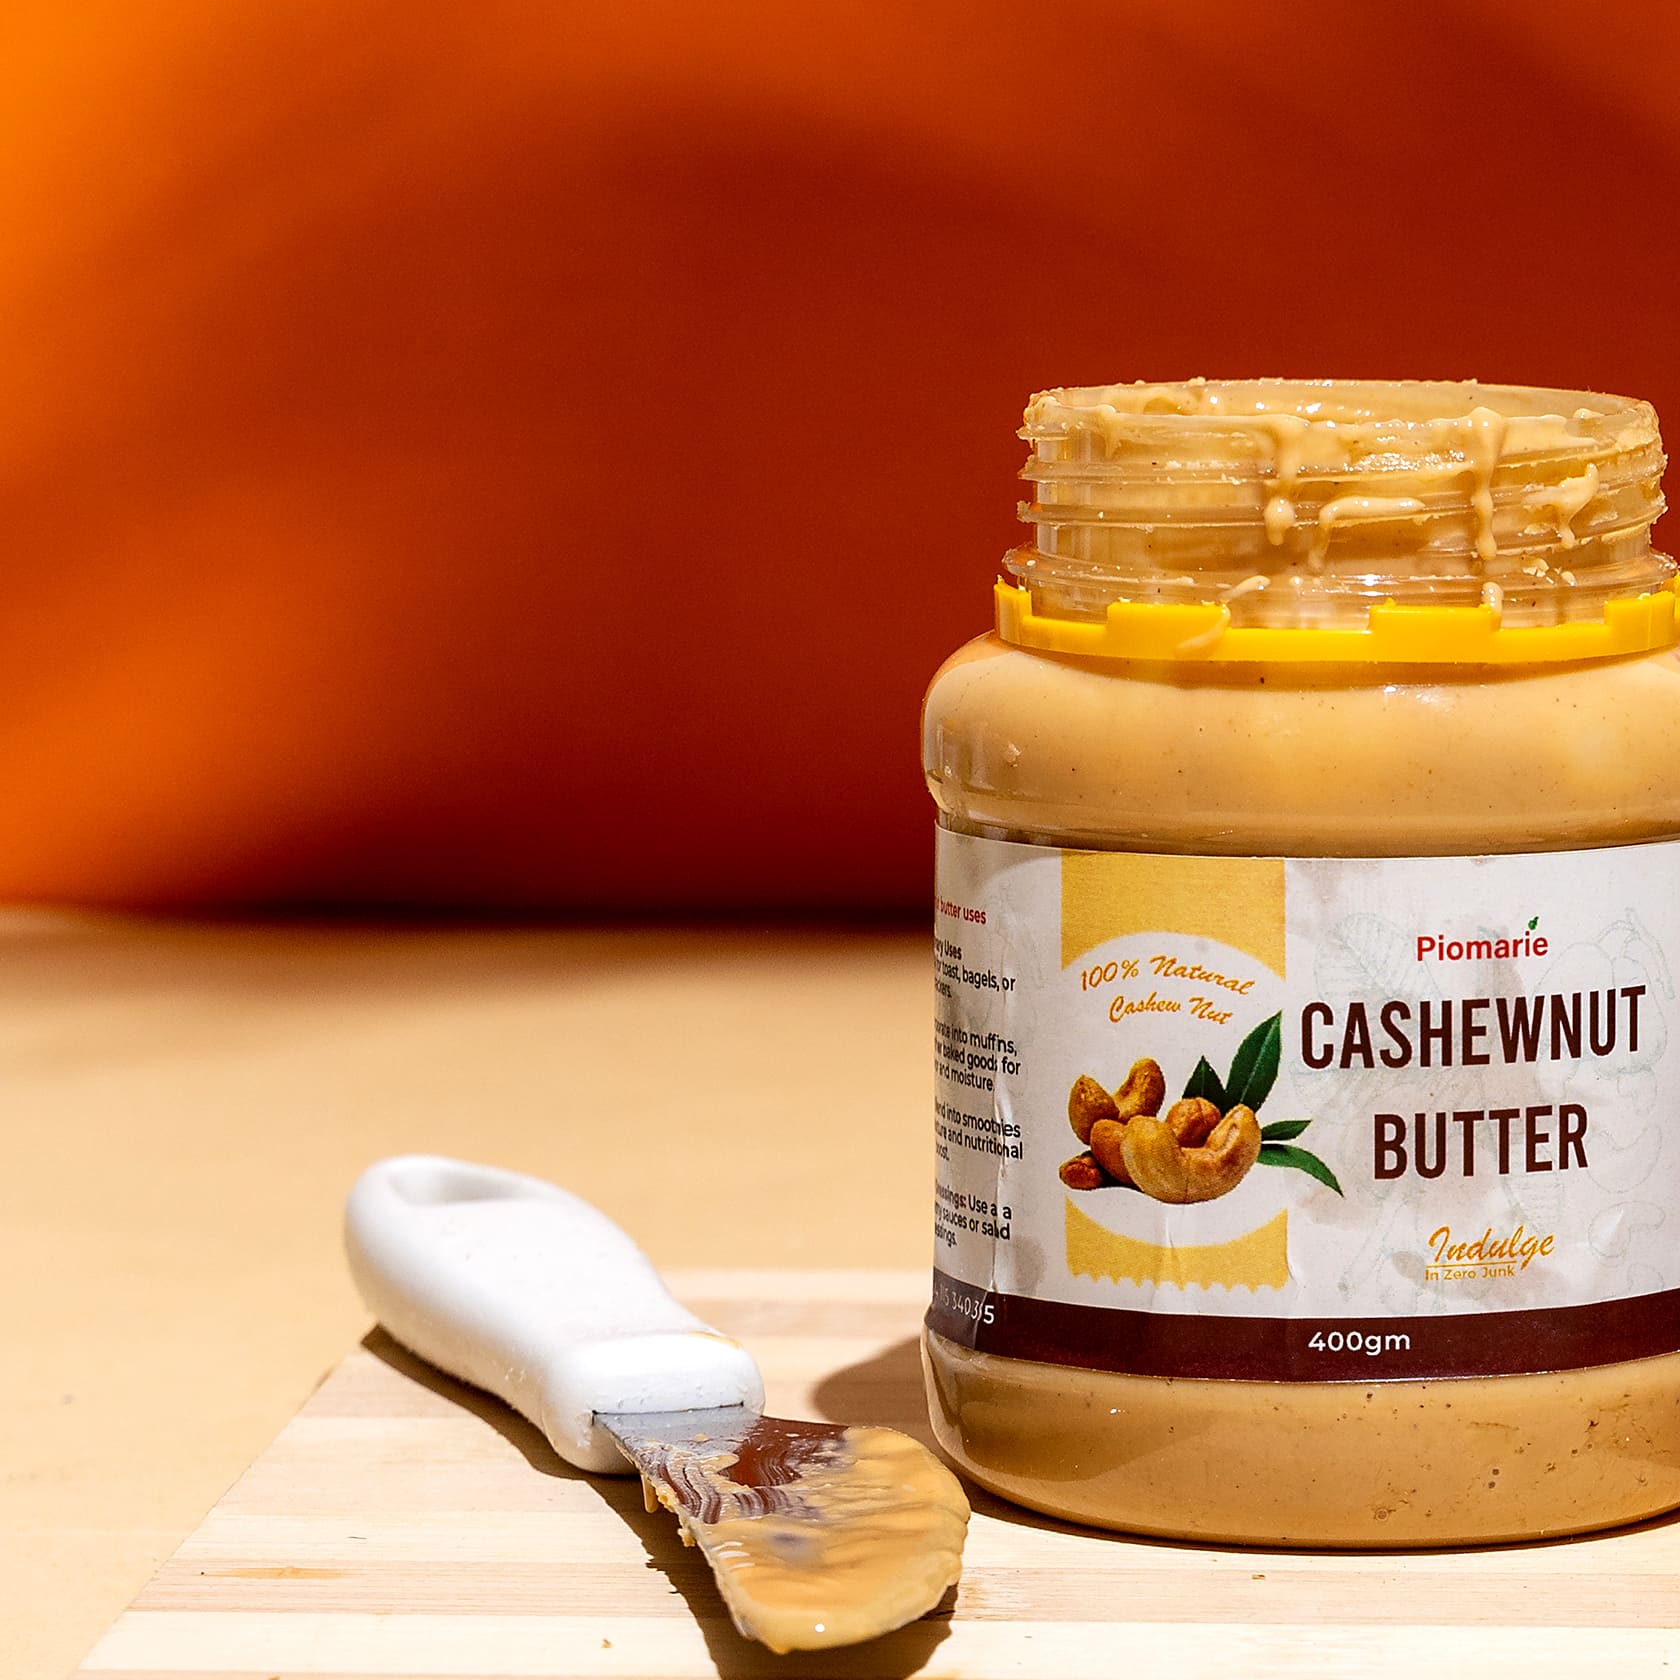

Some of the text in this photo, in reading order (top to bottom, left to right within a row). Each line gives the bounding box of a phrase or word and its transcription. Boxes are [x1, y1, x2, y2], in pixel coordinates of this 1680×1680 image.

[940, 896, 961, 919] butter
[963, 907, 986, 925] uses
[944, 939, 962, 960] Uses
[1416, 928, 1549, 962] Piomarie
[942, 961, 961, 984] toast,
[962, 965, 1000, 993] bagels,
[1002, 977, 1016, 992] or
[1080, 954, 1256, 996] 100% Natural
[1108, 991, 1234, 1025] Cashew Nut
[951, 1023, 968, 1044] into
[1301, 984, 1647, 1070] CASHEWNUT
[943, 1040, 966, 1065] baked
[1001, 1056, 1022, 1076] for
[946, 1104, 961, 1125] into
[962, 1113, 1021, 1138] smoothies
[948, 1129, 963, 1146] and
[964, 1134, 1023, 1160] nutritional
[1374, 1103, 1589, 1181] BUTTER
[943, 1207, 968, 1230] sauces
[969, 1218, 980, 1233] or
[968, 1194, 988, 1215] Use
[1002, 1205, 1012, 1220] a
[1428, 1224, 1555, 1270] Indulge
[1425, 1265, 1516, 1281] In Zero Junk
[1307, 1330, 1411, 1356] 400gm
